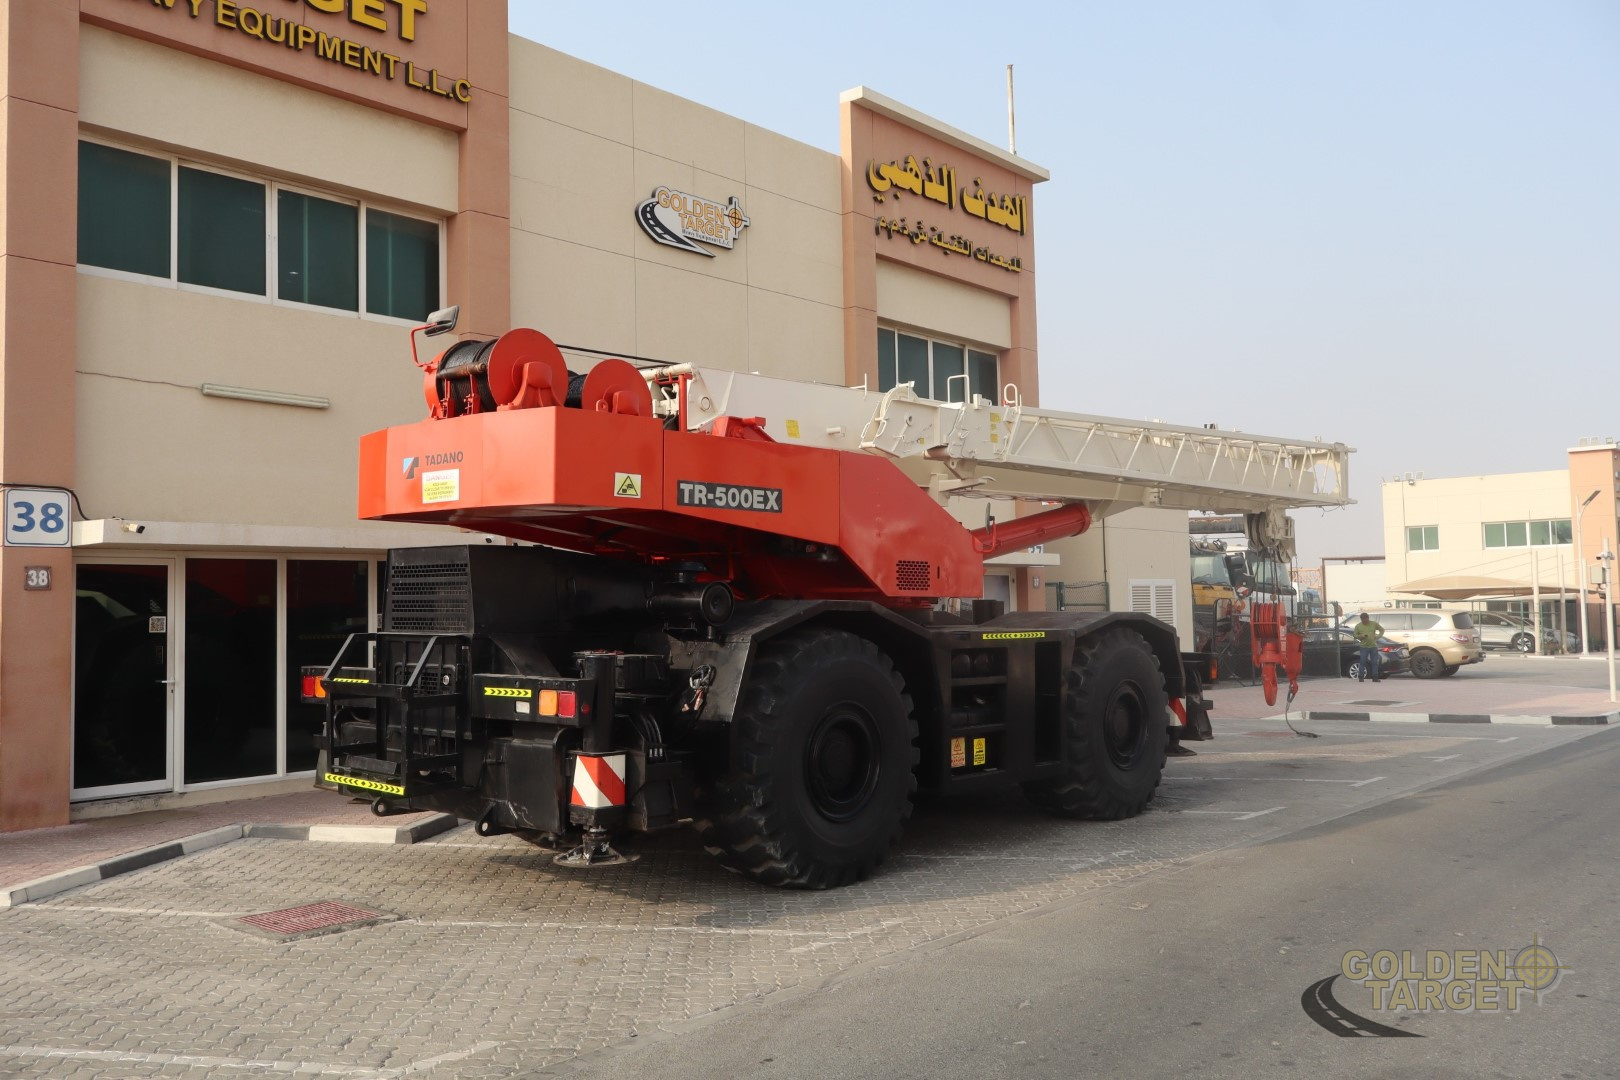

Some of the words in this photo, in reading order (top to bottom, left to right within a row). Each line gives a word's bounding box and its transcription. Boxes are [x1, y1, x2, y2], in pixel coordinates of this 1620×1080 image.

[215, 0, 400, 80] EQUIPMENT
[405, 61, 472, 103] L.L.C
[866, 154, 957, 209] الذهبي
[657, 189, 725, 225] GOLDEN
[960, 177, 1027, 236] الهدف
[678, 212, 731, 240] TARGET
[425, 451, 464, 466] TADANO
[679, 482, 779, 511] TR-500EX
[11, 501, 64, 533] 38
[28, 569, 48, 586] 38
